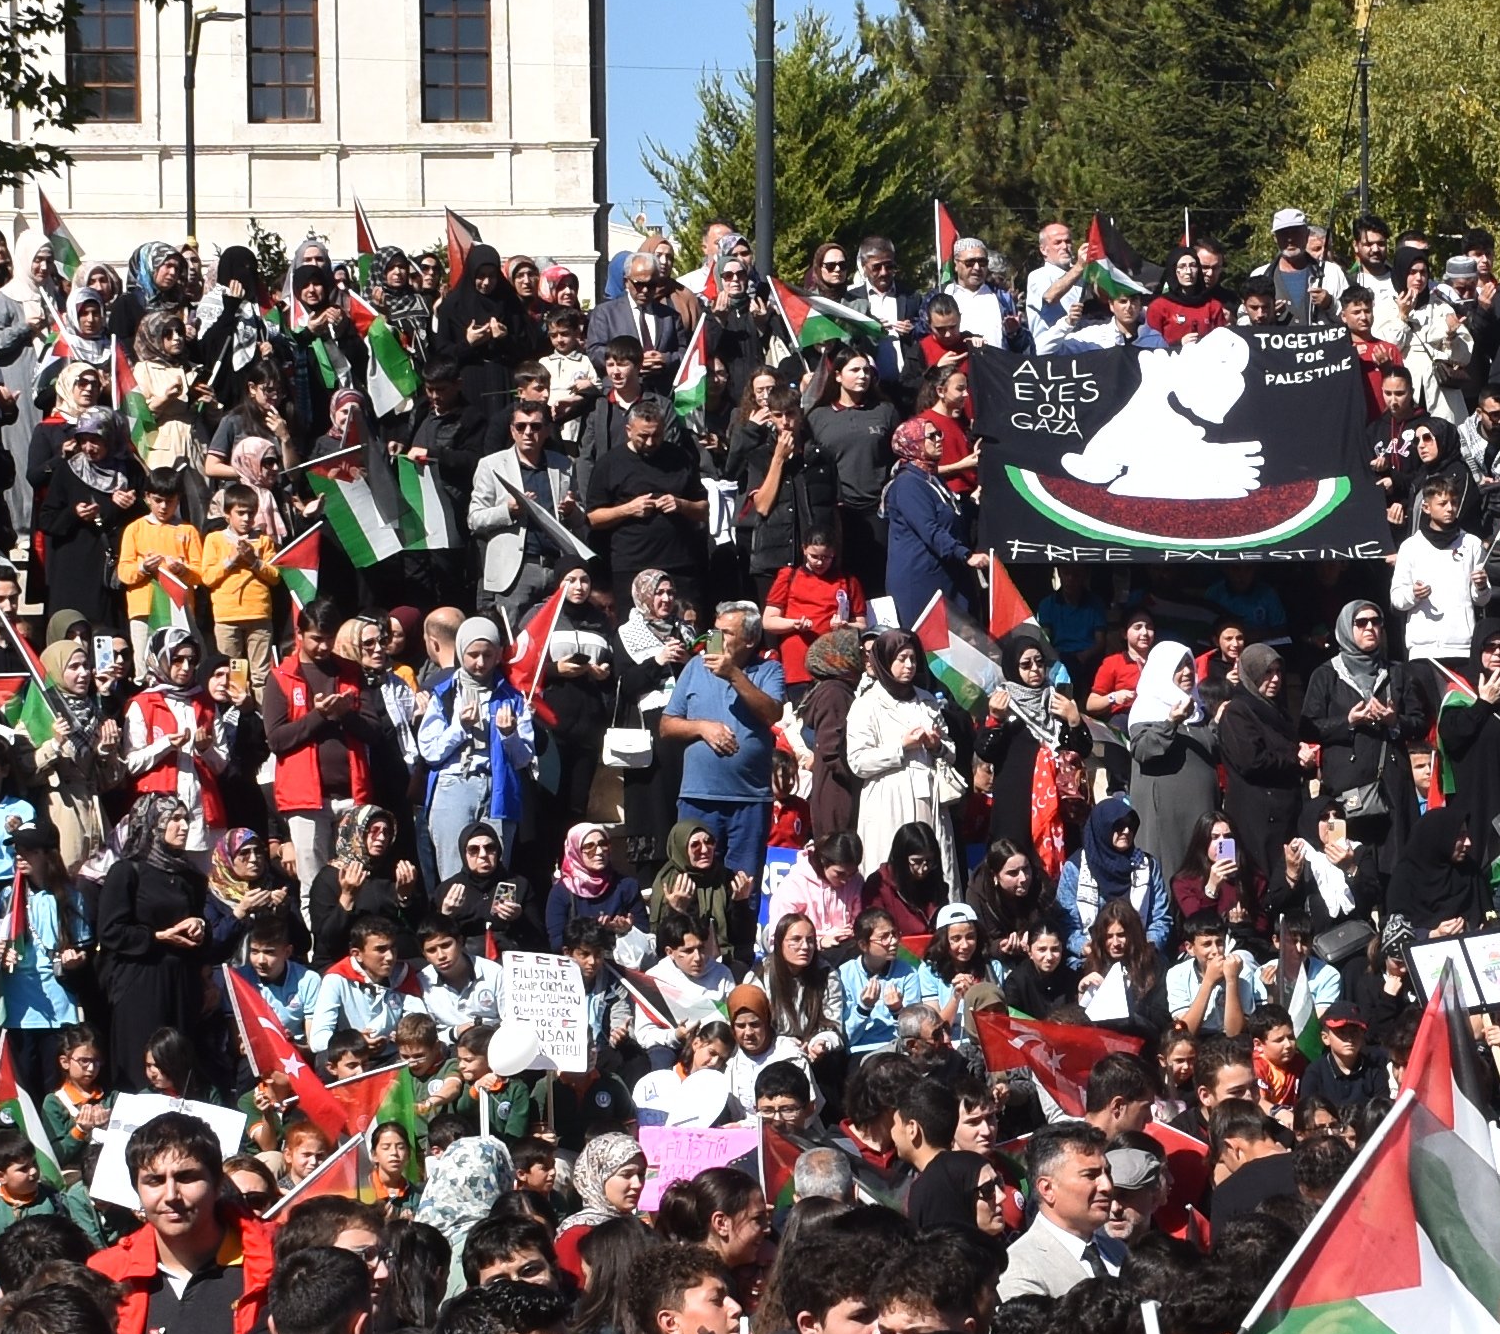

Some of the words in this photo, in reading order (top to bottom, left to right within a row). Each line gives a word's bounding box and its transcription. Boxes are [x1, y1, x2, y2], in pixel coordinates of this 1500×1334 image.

[1254, 327, 1347, 349] TOGETHER
[1296, 349, 1325, 364] FOR
[1012, 359, 1093, 380] ALL
[1265, 356, 1351, 385] PALESTINE
[1014, 380, 1100, 403] EYES
[1037, 403, 1076, 420] ON
[1011, 412, 1084, 440] GAZA
[1006, 539, 1133, 561] FREE
[1160, 541, 1386, 561] PALESTINE
